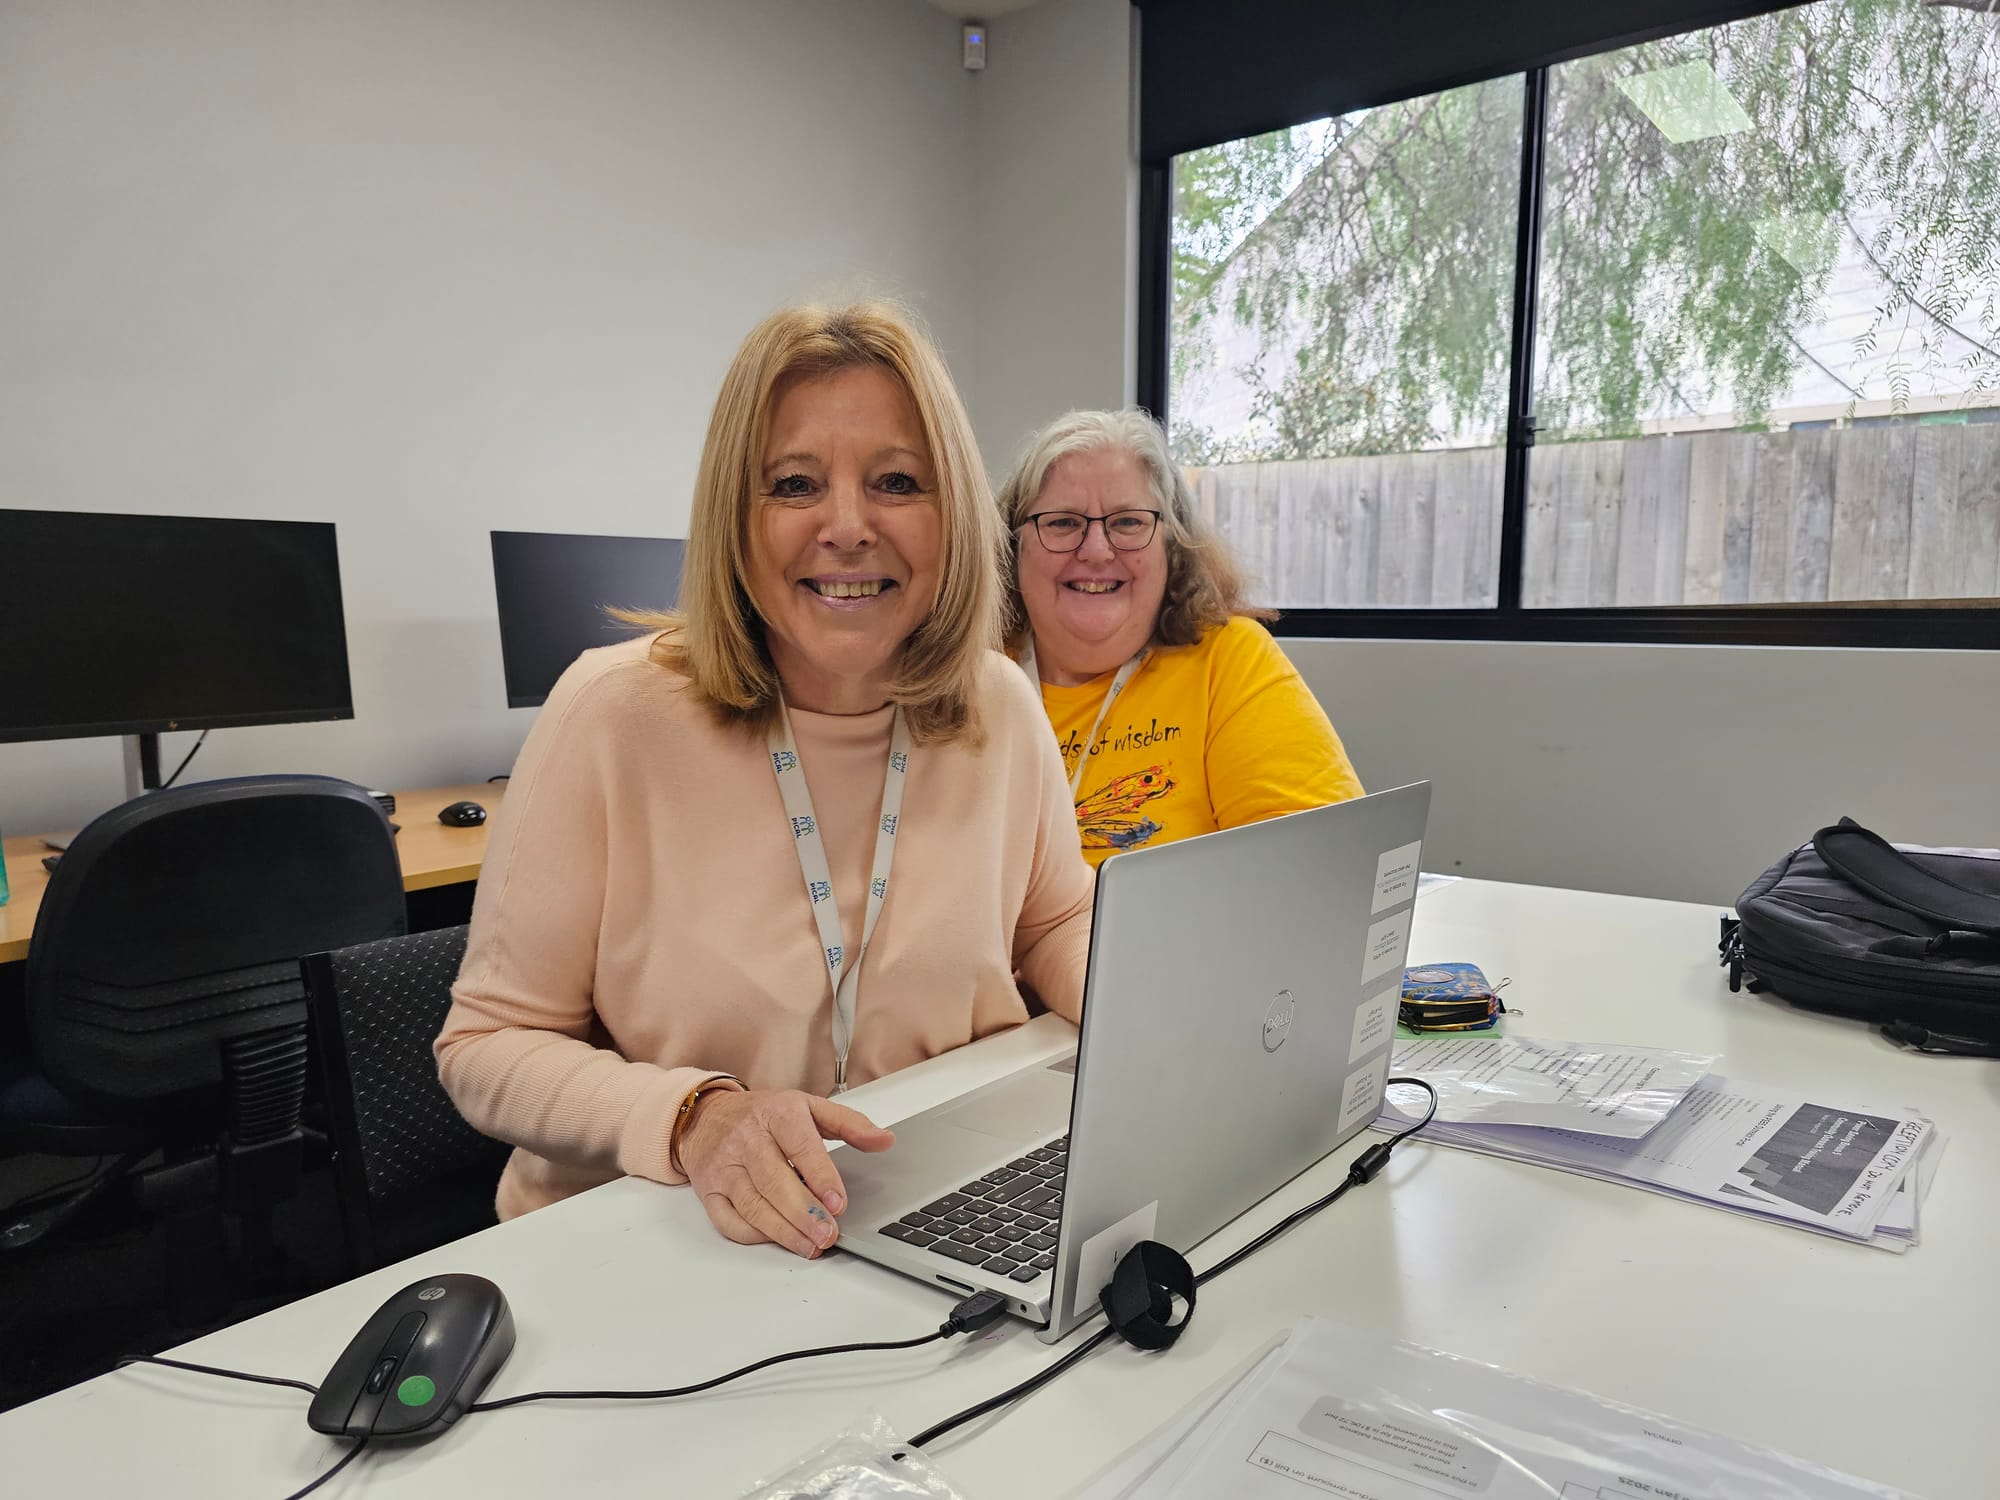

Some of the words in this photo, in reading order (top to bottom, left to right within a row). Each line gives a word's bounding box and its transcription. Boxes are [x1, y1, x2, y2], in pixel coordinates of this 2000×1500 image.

[1090, 726, 1111, 756] of
[1114, 719, 1182, 752] wisdom
[773, 752, 783, 774] PICAL
[792, 817, 801, 838] PICAL
[810, 882, 819, 904] PICAL
[827, 948, 835, 969] PICAL
[1867, 1170, 1883, 1178] DO
[1259, 1455, 1273, 1467] ($)
[1275, 1461, 1289, 1473] bill
[1292, 1468, 1304, 1477] on
[1307, 1474, 1346, 1491] amount
[1618, 1476, 1651, 1492] 2025
